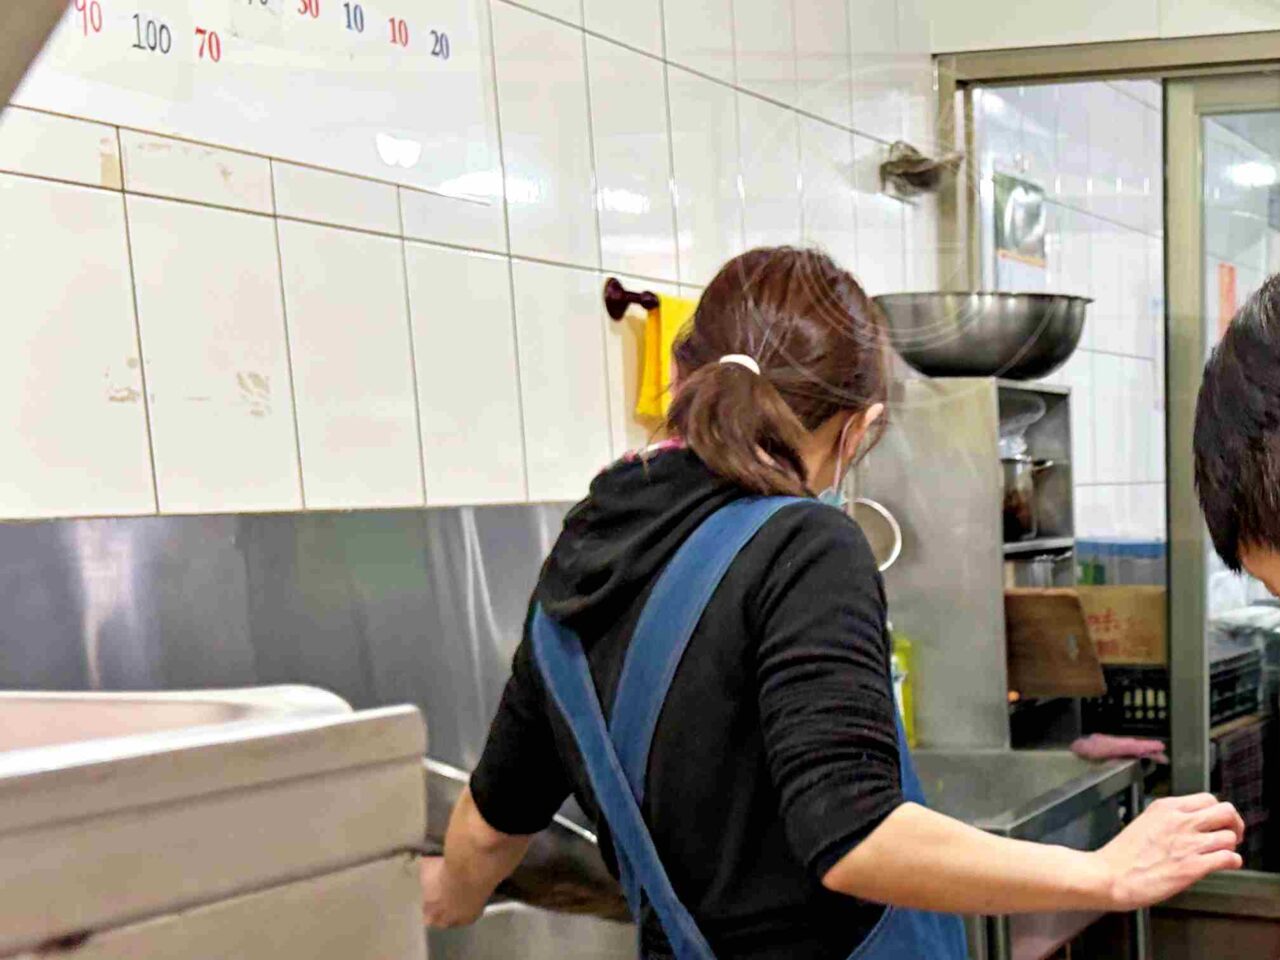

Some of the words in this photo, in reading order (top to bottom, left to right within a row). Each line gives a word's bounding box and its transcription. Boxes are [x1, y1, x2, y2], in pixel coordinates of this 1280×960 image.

[343, 2, 364, 33] 10
[389, 16, 409, 47] 10
[132, 13, 172, 54] 100
[195, 26, 221, 63] 70
[430, 29, 450, 60] 20
